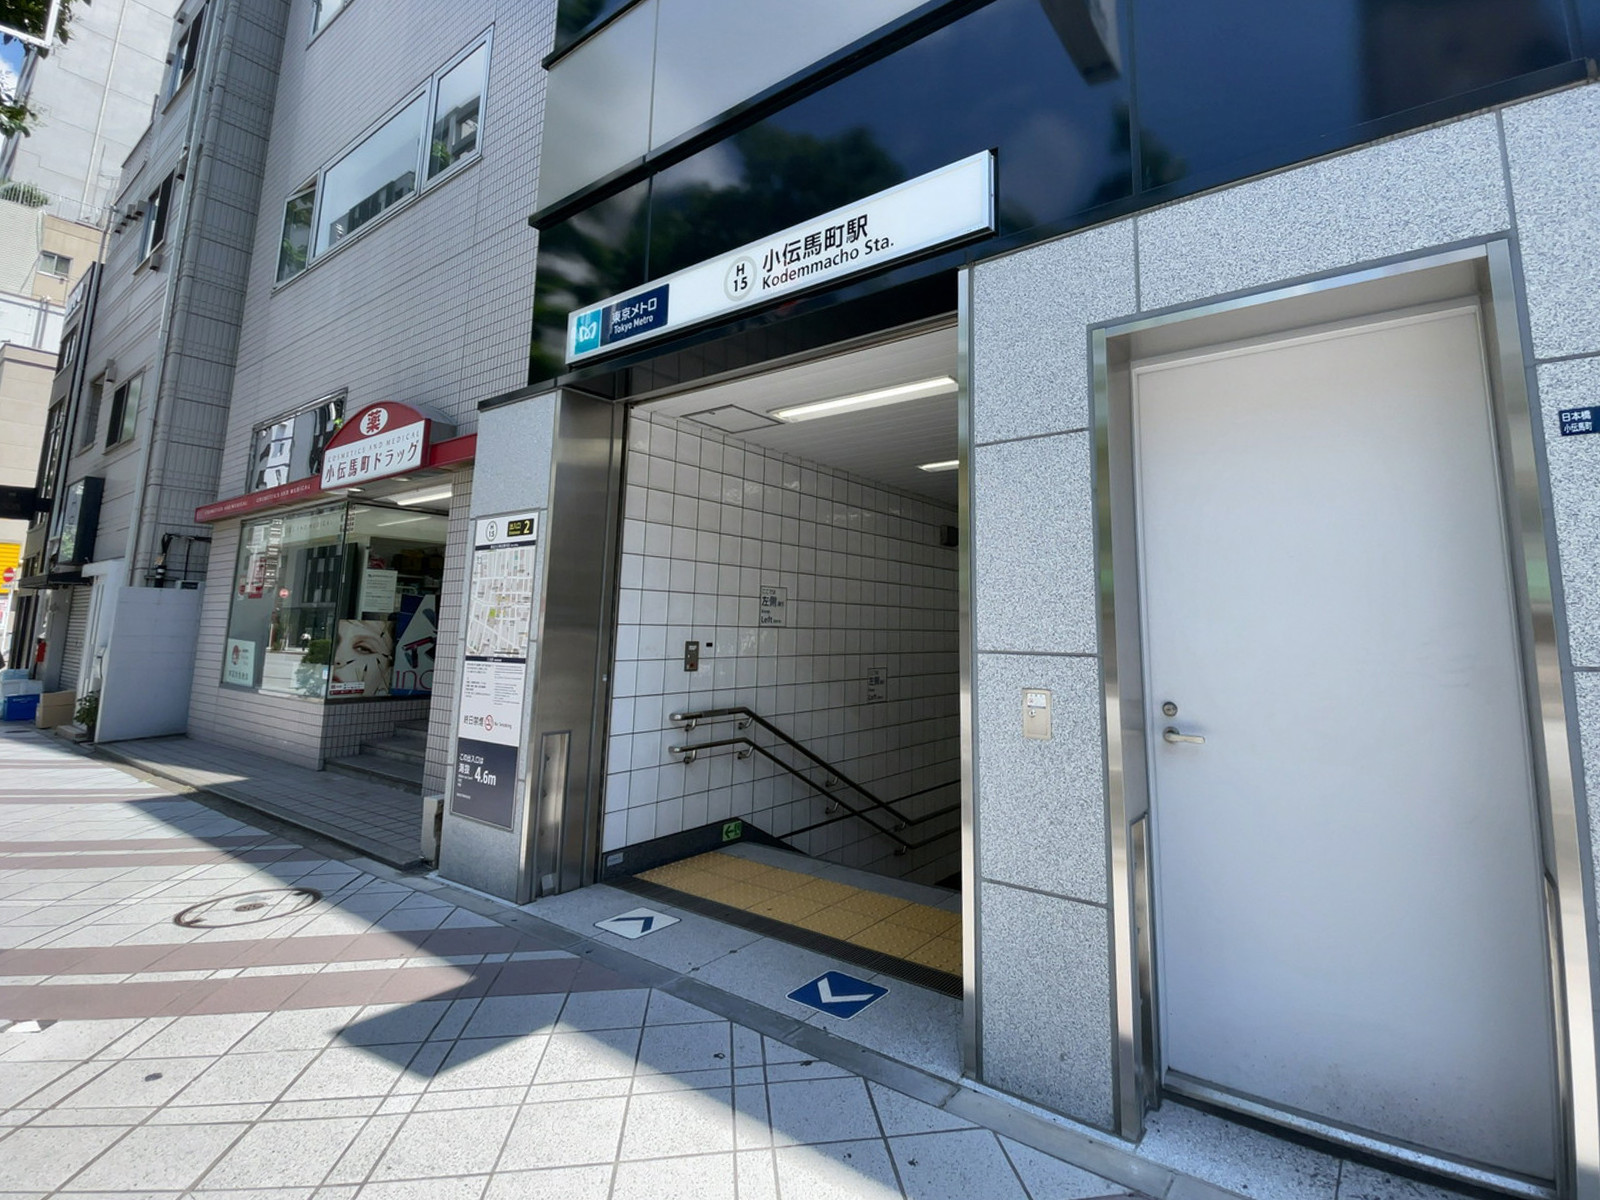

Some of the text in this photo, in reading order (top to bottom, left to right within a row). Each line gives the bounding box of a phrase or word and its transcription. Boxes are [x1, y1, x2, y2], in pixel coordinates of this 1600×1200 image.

[762, 214, 868, 273] 小伝馬町駅
[736, 263, 745, 277] H
[762, 237, 895, 290] Kodemmacho Sta.
[733, 277, 748, 292] 15
[612, 297, 657, 324] 東京メトロ
[613, 315, 654, 334] Tokyo Metro
[366, 409, 382, 434] 薬
[1562, 410, 1592, 422] 日本橋
[328, 430, 420, 463] COSMETICS AND MEDICAL
[325, 439, 420, 483] 小伝馬町ドラッグ
[523, 520, 531, 534] 2
[761, 615, 773, 624] Left
[459, 753, 484, 764] この出入口は
[474, 766, 497, 786] 4.6m
